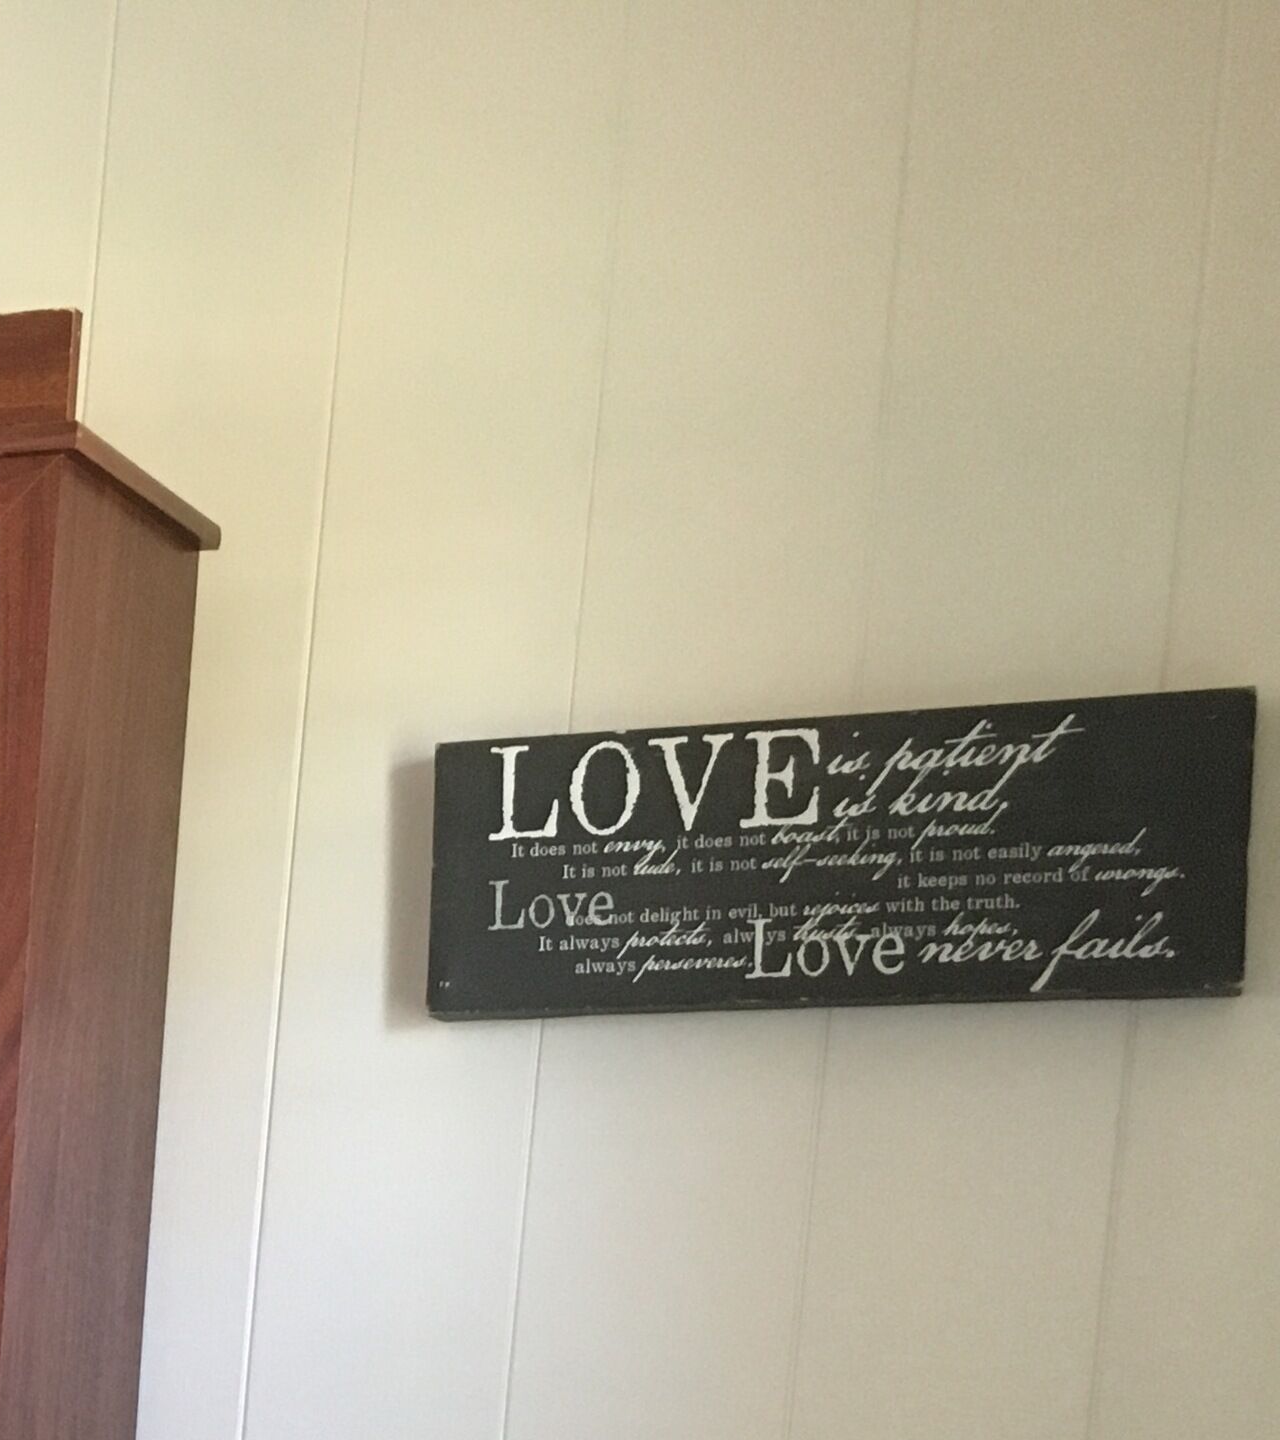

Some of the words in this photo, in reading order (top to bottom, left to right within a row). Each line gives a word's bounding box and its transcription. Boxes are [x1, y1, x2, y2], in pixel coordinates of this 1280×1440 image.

[489, 728, 819, 840] LOVE
[827, 730, 871, 775] is
[865, 713, 1085, 796] patient
[833, 774, 877, 817] is
[889, 764, 1018, 817] kind,
[511, 843, 525, 858] It
[529, 842, 566, 858] does
[572, 841, 598, 854] not
[603, 838, 666, 872] envy,
[676, 830, 689, 850] it
[694, 833, 733, 849] does
[740, 833, 767, 846] not
[770, 819, 851, 845] boast,
[846, 827, 859, 841] it
[866, 825, 880, 840] is
[887, 826, 915, 839] not
[910, 803, 1006, 850] proud.
[562, 864, 576, 879] It
[582, 864, 595, 878] is
[601, 863, 627, 878] not
[691, 858, 703, 873] it
[709, 856, 723, 872] is
[730, 857, 757, 871] not
[761, 837, 903, 883] self-seeking,
[910, 848, 923, 863] it
[929, 848, 944, 862] is
[952, 846, 981, 860] not
[987, 842, 1041, 861] easily
[1047, 827, 1147, 873] angered,
[488, 880, 614, 931] Love
[608, 910, 634, 925] not
[640, 904, 700, 926] delight
[706, 904, 721, 920] in
[728, 902, 763, 920] evil,
[769, 901, 798, 918] but
[803, 891, 880, 926] rejoices
[886, 897, 925, 913] with
[932, 896, 960, 911] the
[967, 893, 1021, 911] truth.
[897, 874, 910, 889] it
[918, 872, 968, 890] keeps
[975, 873, 996, 886] no
[1003, 867, 1063, 885] record
[1070, 866, 1091, 883] of
[1094, 866, 1185, 897] wrongs.
[538, 936, 553, 951] It
[559, 934, 619, 952] always
[616, 921, 712, 960] protects,
[723, 928, 786, 945] alwys
[871, 922, 936, 941] always
[944, 911, 1018, 944] hopes,
[745, 918, 905, 979] Love
[917, 939, 1043, 963] never
[1030, 908, 1175, 993] fails.
[575, 958, 636, 976] always
[632, 954, 753, 983] perseveres.
